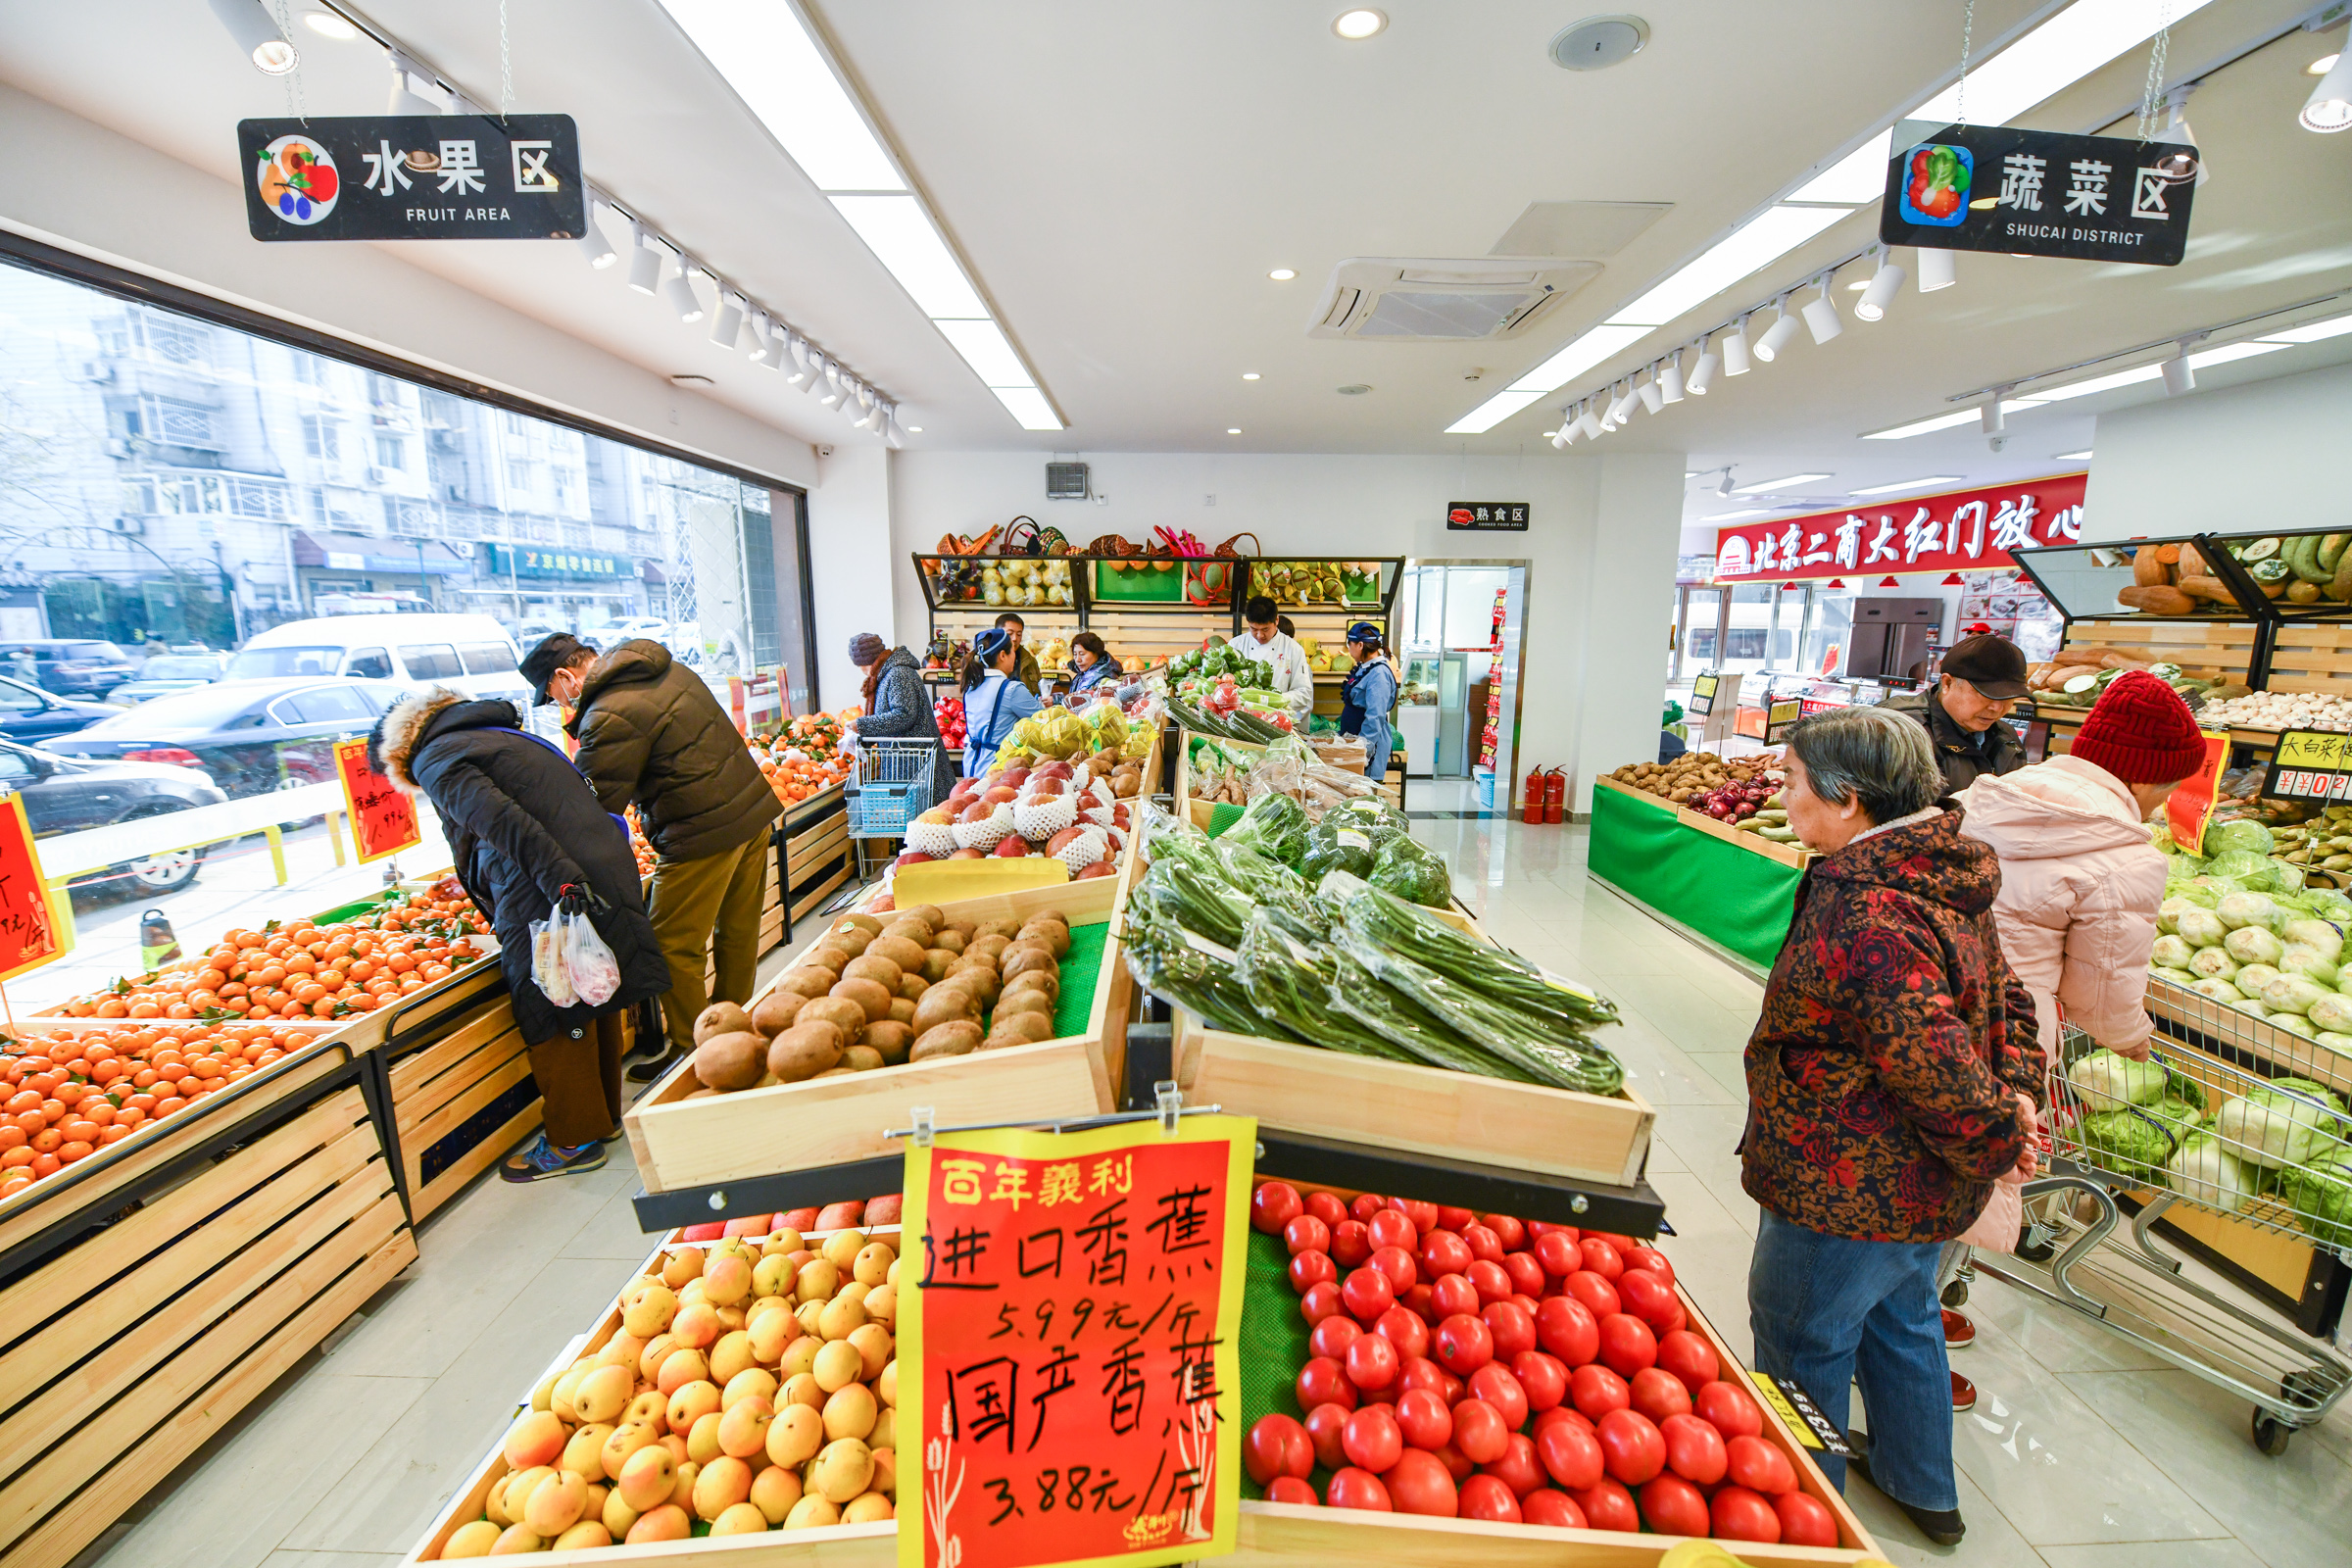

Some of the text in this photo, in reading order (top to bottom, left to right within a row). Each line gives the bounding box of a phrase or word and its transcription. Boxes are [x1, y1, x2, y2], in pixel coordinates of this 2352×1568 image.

[362, 139, 560, 197] 水果区
[1997, 154, 2175, 220] 蔬菜区
[406, 207, 512, 222] FRUIT AREA
[2006, 222, 2144, 247] SHUCAI DISTRICT
[1476, 507, 1524, 521] 熟食区
[1753, 494, 2084, 573] 北京二商大红门放心
[940, 1153, 1134, 1212] 百年義利
[917, 1185, 1213, 1292] 进口香蕉
[946, 1333, 1225, 1454] 国产香蕉
